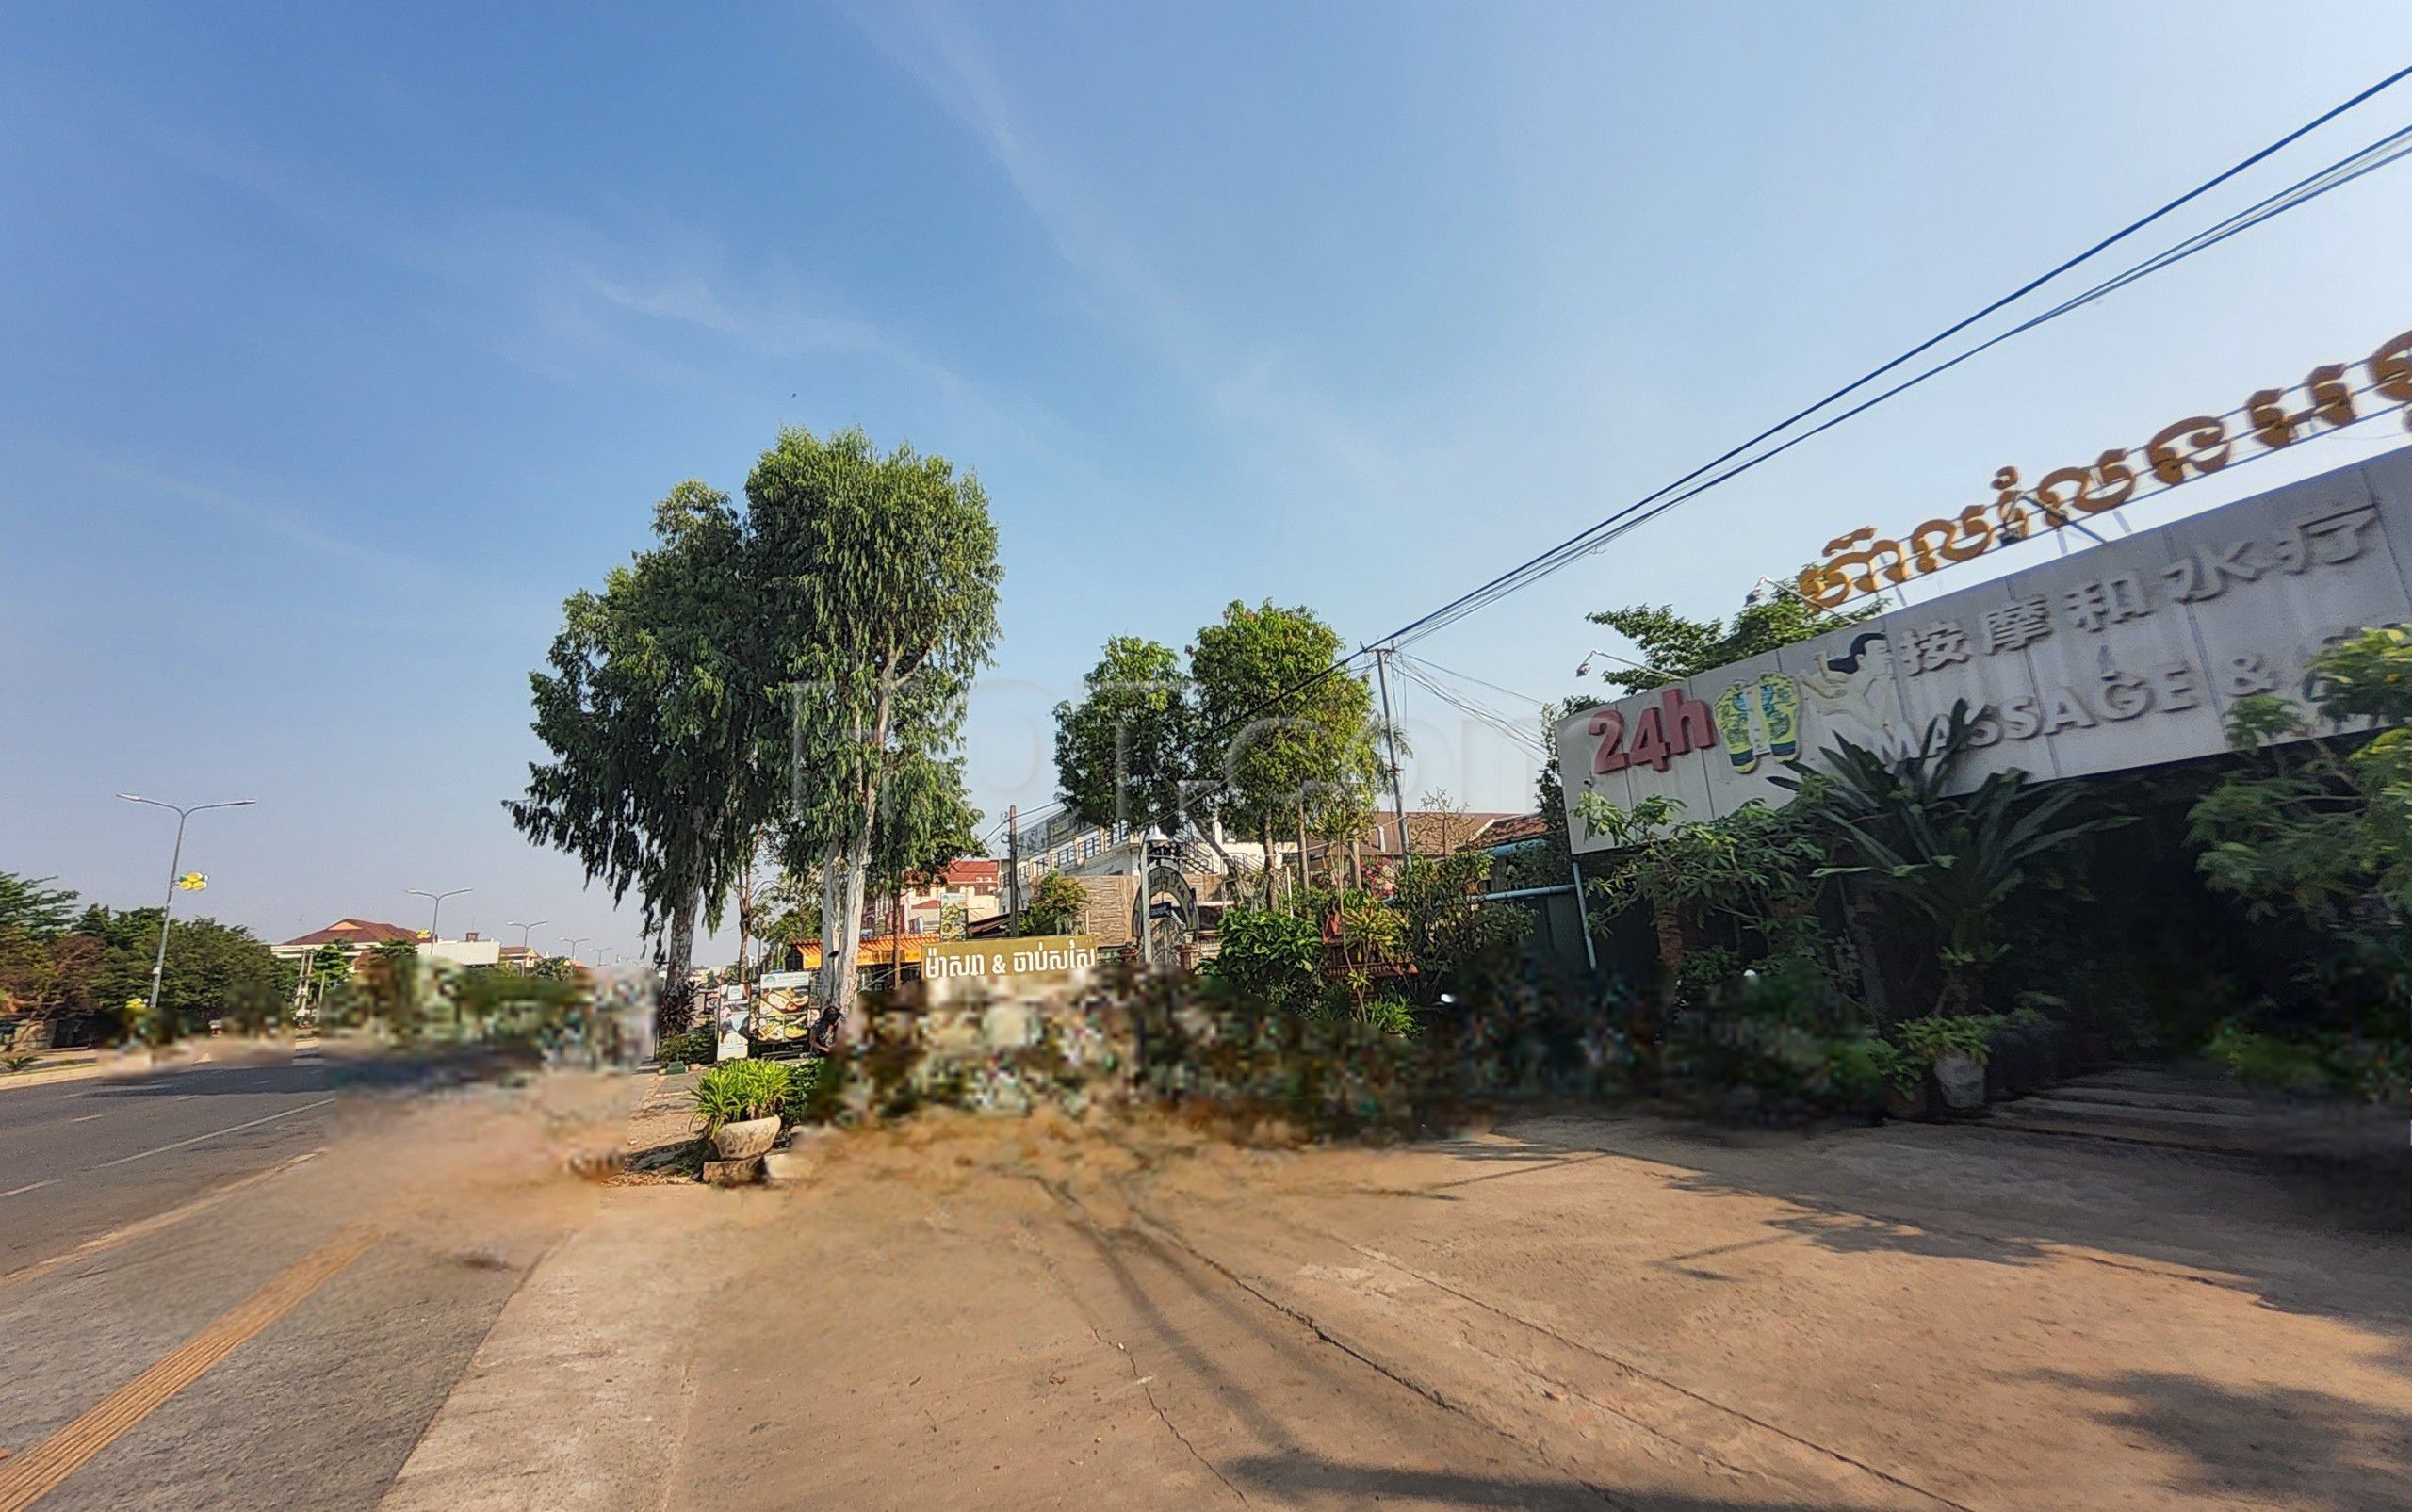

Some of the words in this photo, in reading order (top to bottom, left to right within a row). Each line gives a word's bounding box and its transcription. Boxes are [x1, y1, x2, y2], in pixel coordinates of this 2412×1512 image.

[1898, 502, 2380, 677] 按摩和水疗
[1588, 689, 1717, 773] 24h
[1870, 659, 2200, 764] MASSAGE
[2225, 653, 2281, 698] &
[991, 953, 1007, 975] &
